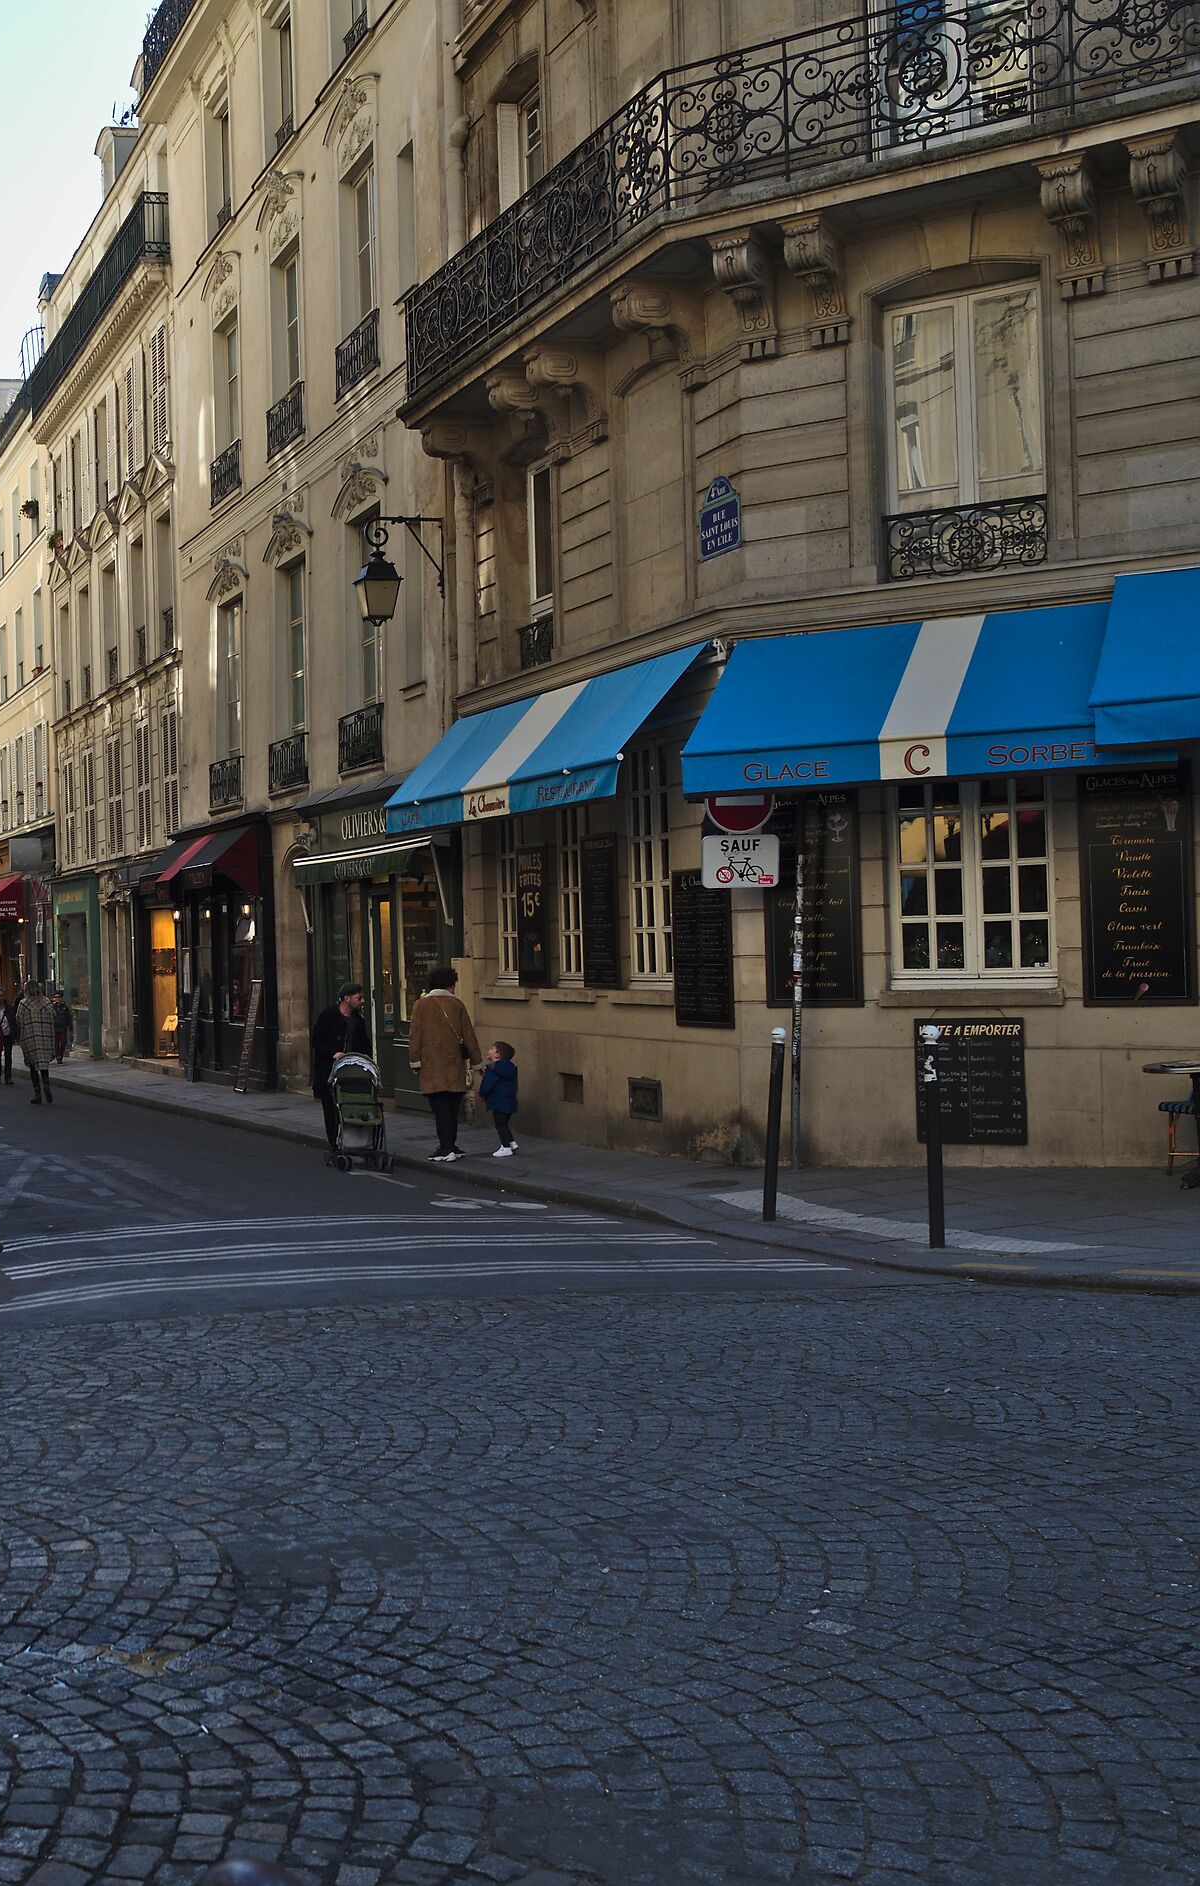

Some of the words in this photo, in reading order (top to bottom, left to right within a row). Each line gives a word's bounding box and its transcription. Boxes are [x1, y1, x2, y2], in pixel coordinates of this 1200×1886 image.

[712, 509, 726, 523] RUE
[701, 524, 719, 540] SAINT
[720, 516, 738, 531] LOUIS
[904, 744, 930, 775] C
[744, 760, 829, 781] GLACE
[1086, 776, 1127, 791] GLACES
[1139, 772, 1177, 788] ALPES
[816, 793, 847, 806] ALPES
[720, 839, 761, 852] SAUF
[1115, 851, 1152, 862] Vanille
[519, 873, 542, 887] FRITES
[1112, 868, 1152, 879] Violette
[1120, 885, 1151, 897] Fraise
[521, 892, 541, 918] 15€
[1119, 902, 1147, 913] Cassis
[1107, 921, 1136, 932] Citron
[1112, 940, 1161, 951] Framboise
[1122, 957, 1152, 968] Fruit
[1102, 969, 1113, 978] de
[1116, 969, 1127, 978] la
[1129, 970, 1169, 983] passion
[954, 1025, 962, 1036] A
[963, 1024, 1021, 1036] EMPORTER
